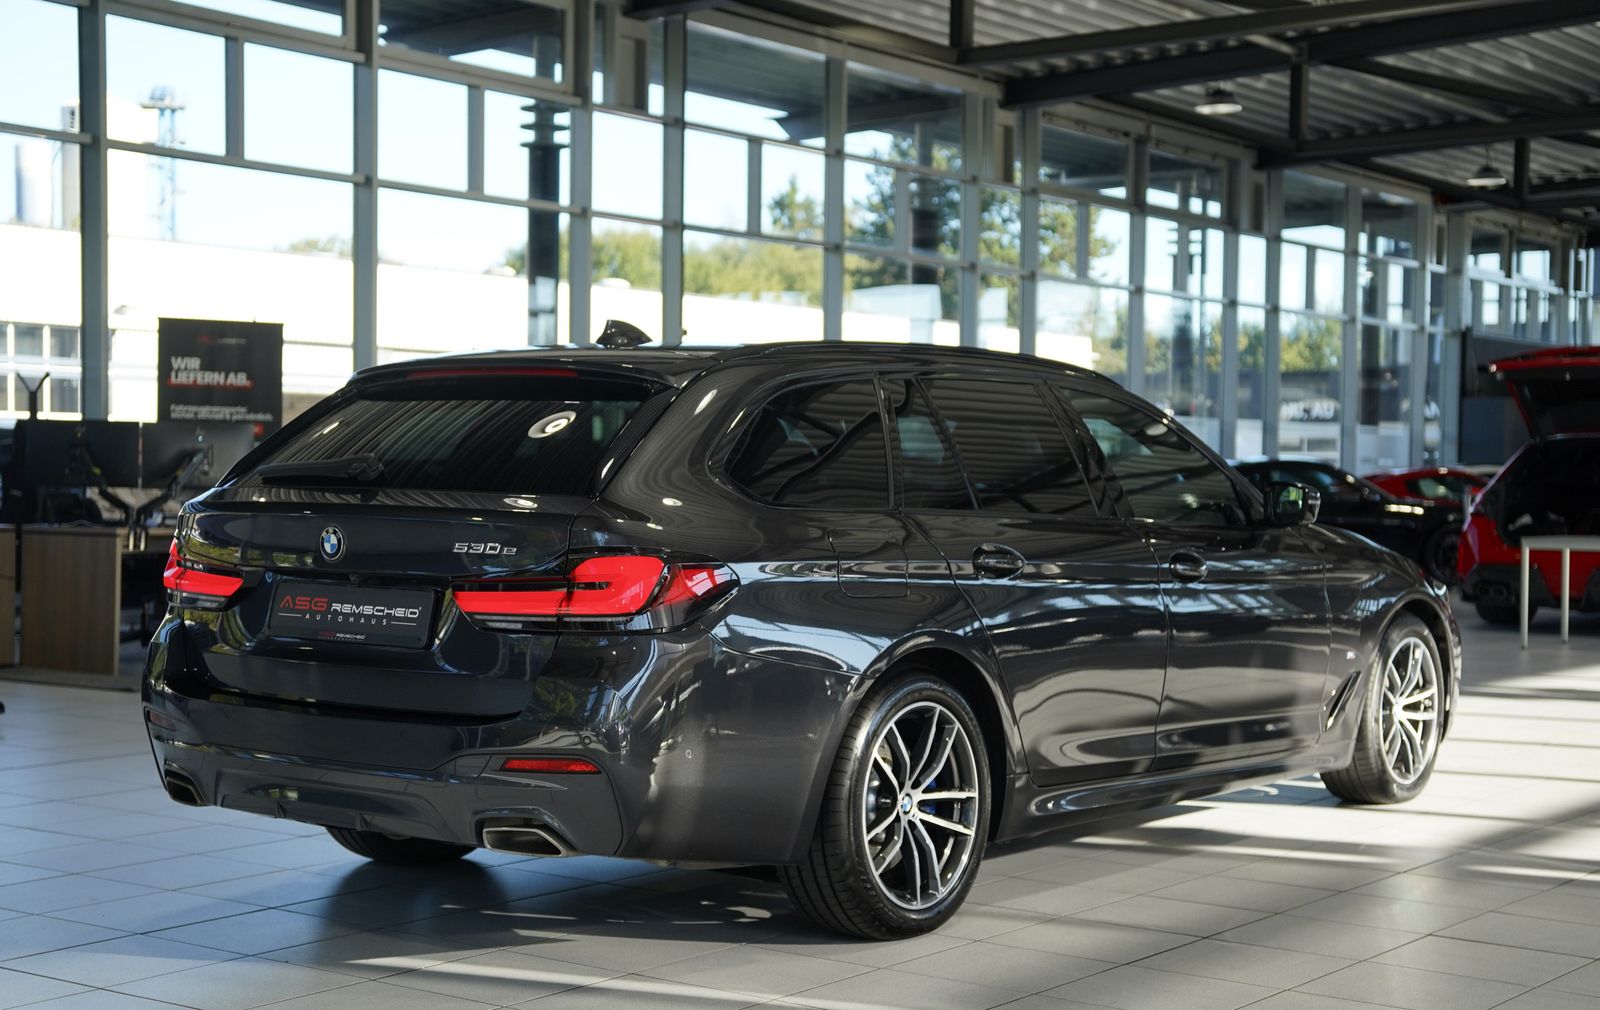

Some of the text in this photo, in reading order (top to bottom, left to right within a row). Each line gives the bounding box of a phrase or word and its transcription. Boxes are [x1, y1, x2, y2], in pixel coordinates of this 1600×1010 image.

[170, 356, 201, 370] WIR
[170, 370, 251, 387] LIEFERN AB.
[279, 594, 420, 618] ASG REMSCHEID
[305, 613, 387, 625] AUTOHAUS
